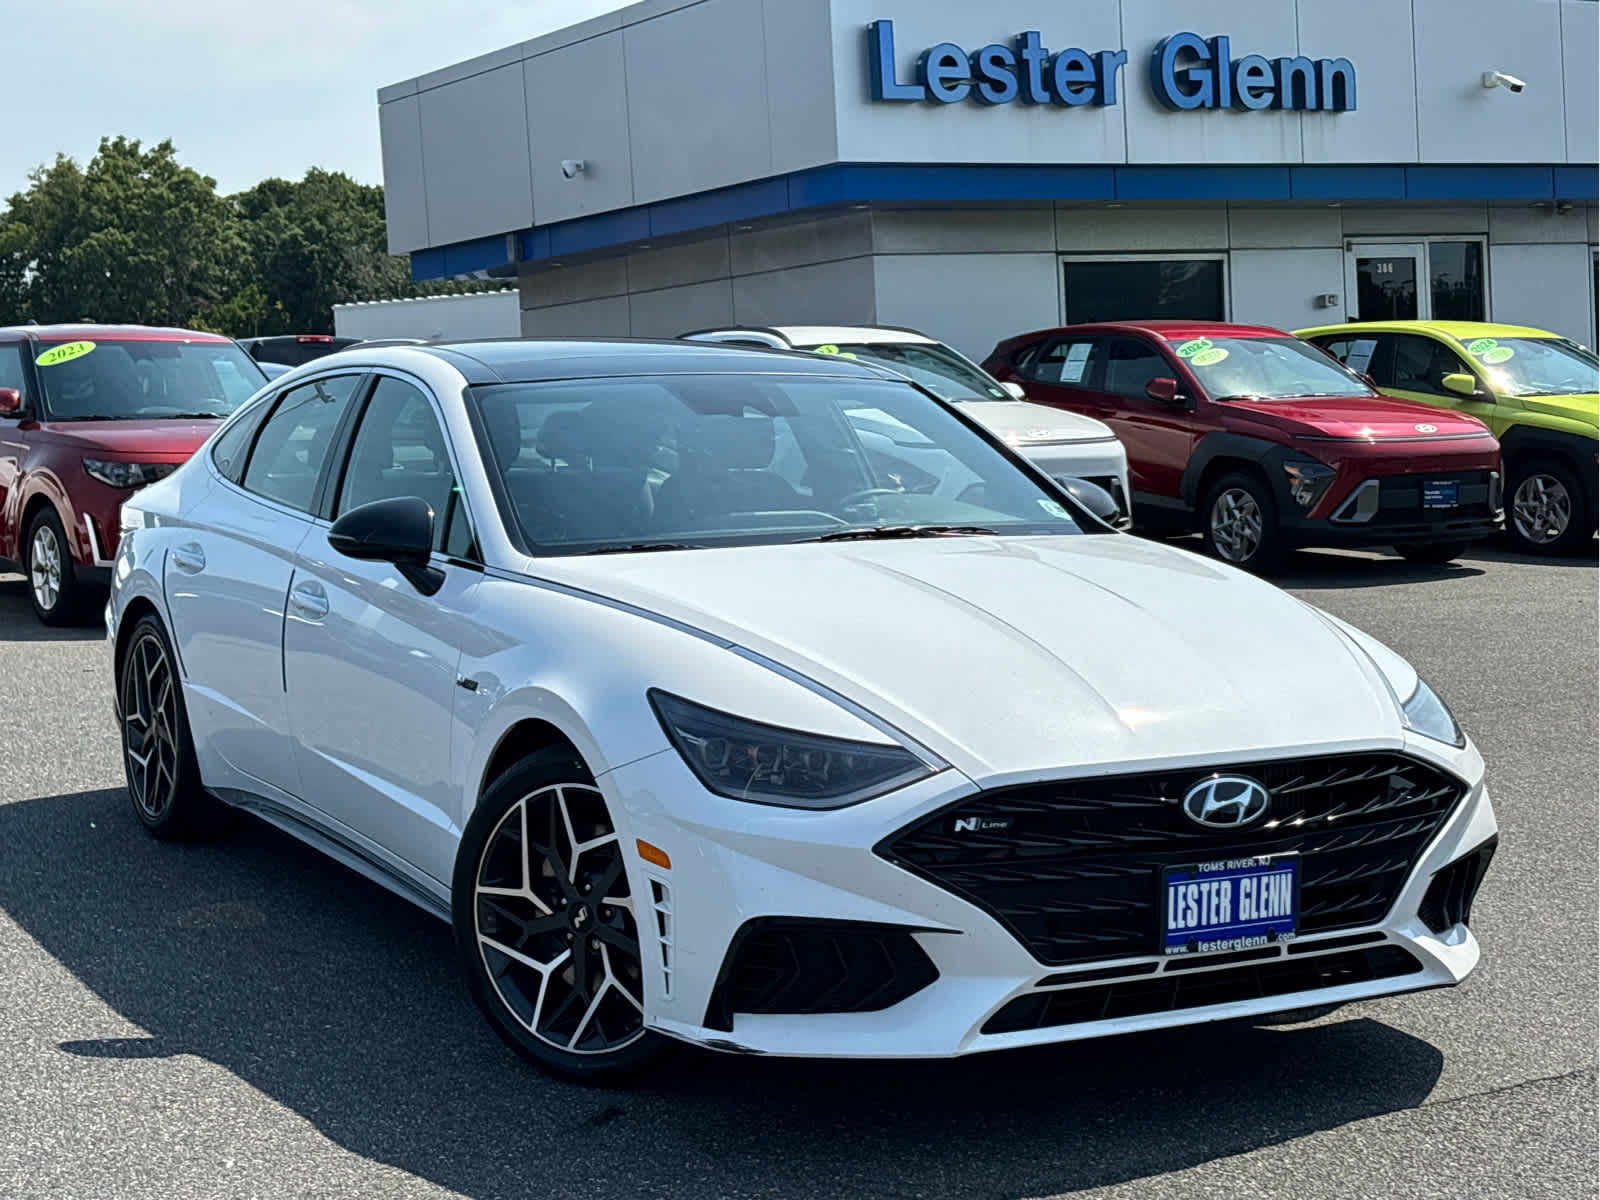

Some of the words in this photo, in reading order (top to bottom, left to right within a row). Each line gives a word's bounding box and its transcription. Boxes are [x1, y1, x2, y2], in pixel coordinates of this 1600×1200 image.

[866, 19, 1128, 106] Lester
[1151, 31, 1357, 112] Glenn
[48, 343, 85, 363] 2023
[1179, 340, 1210, 356] 2024
[954, 816, 977, 832] N
[1198, 862, 1225, 873] TOMS
[1258, 855, 1271, 866] NJ
[1168, 881, 1231, 929] LESTER
[1239, 873, 1292, 920] GLENN
[1198, 935, 1268, 952] lesterglenn
